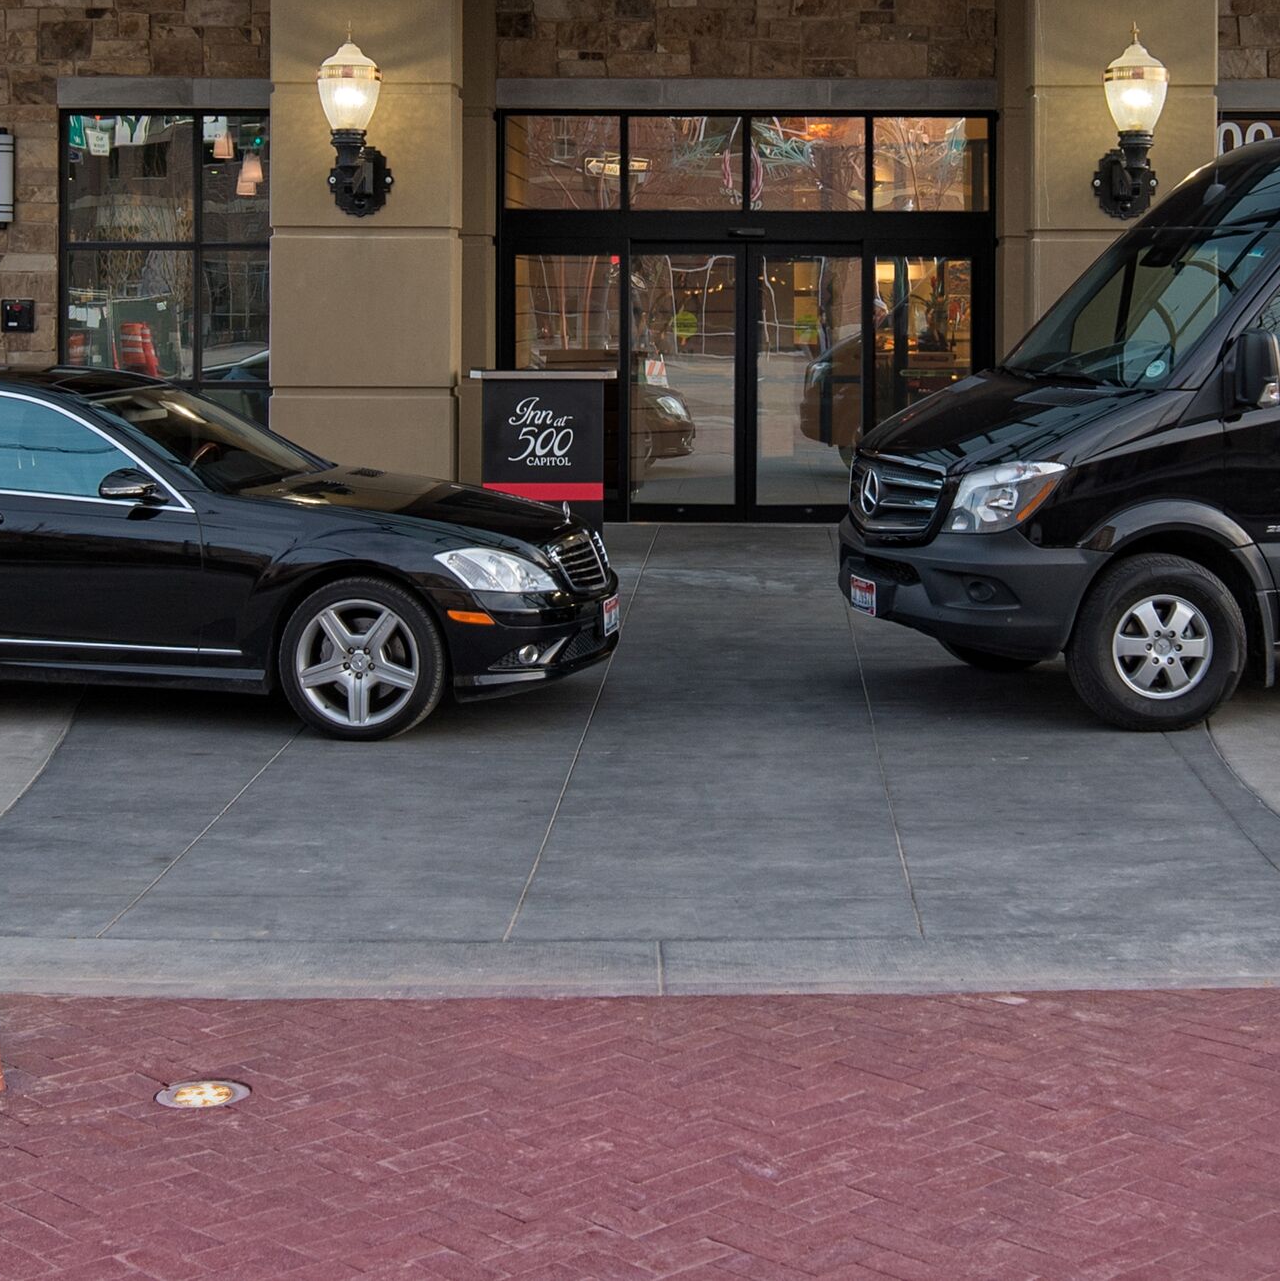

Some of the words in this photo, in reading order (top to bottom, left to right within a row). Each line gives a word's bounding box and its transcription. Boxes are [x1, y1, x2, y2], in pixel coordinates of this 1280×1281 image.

[508, 396, 554, 426] Inn
[553, 415, 574, 427] at
[508, 426, 574, 462] 500
[526, 456, 572, 467] CAPITOL
